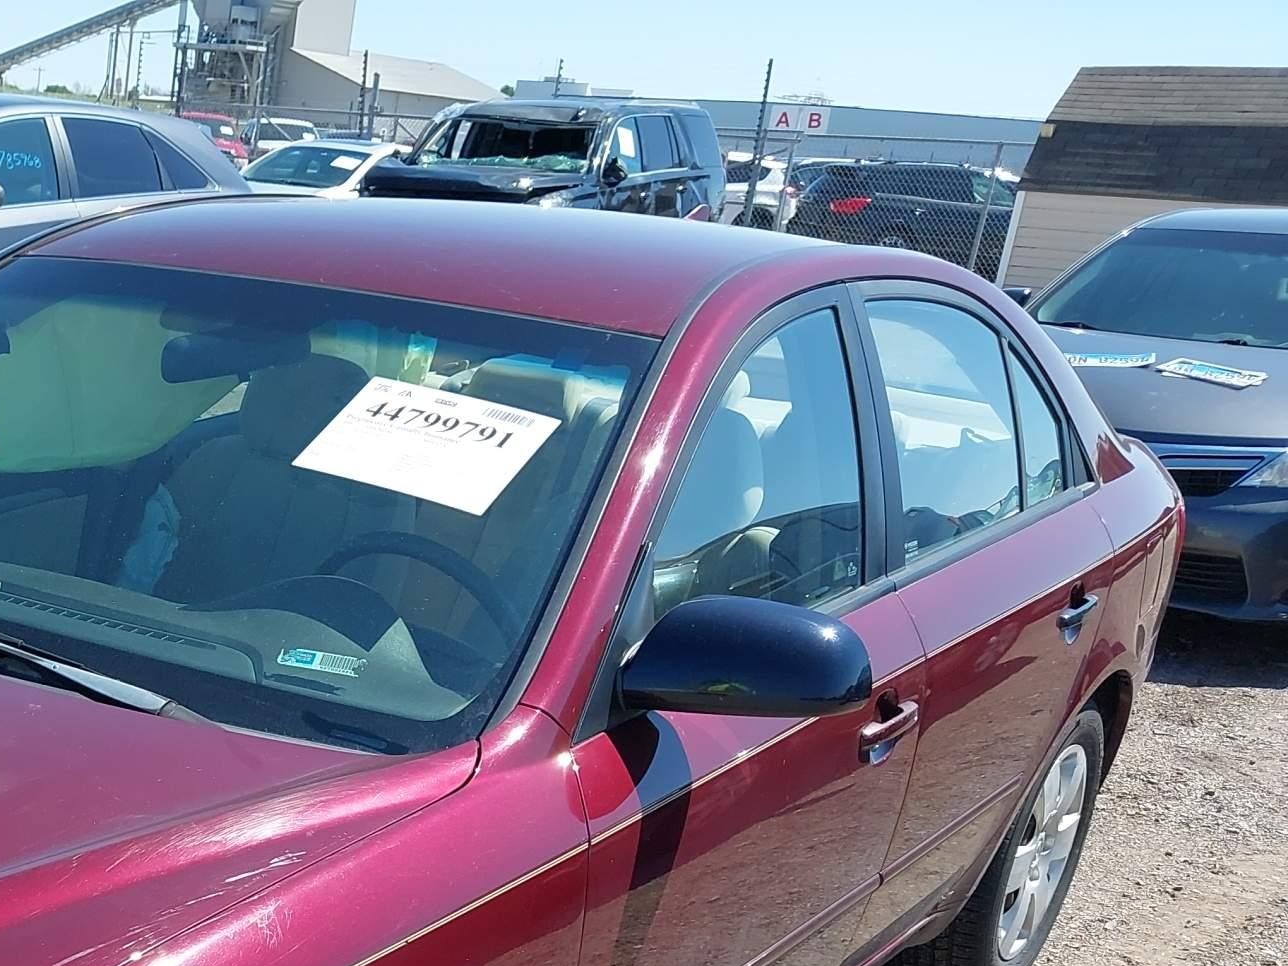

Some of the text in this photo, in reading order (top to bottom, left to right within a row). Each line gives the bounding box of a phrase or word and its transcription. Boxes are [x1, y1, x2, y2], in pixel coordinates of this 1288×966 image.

[775, 111, 790, 128] A
[807, 112, 823, 129] B
[365, 401, 514, 449] 44799791
